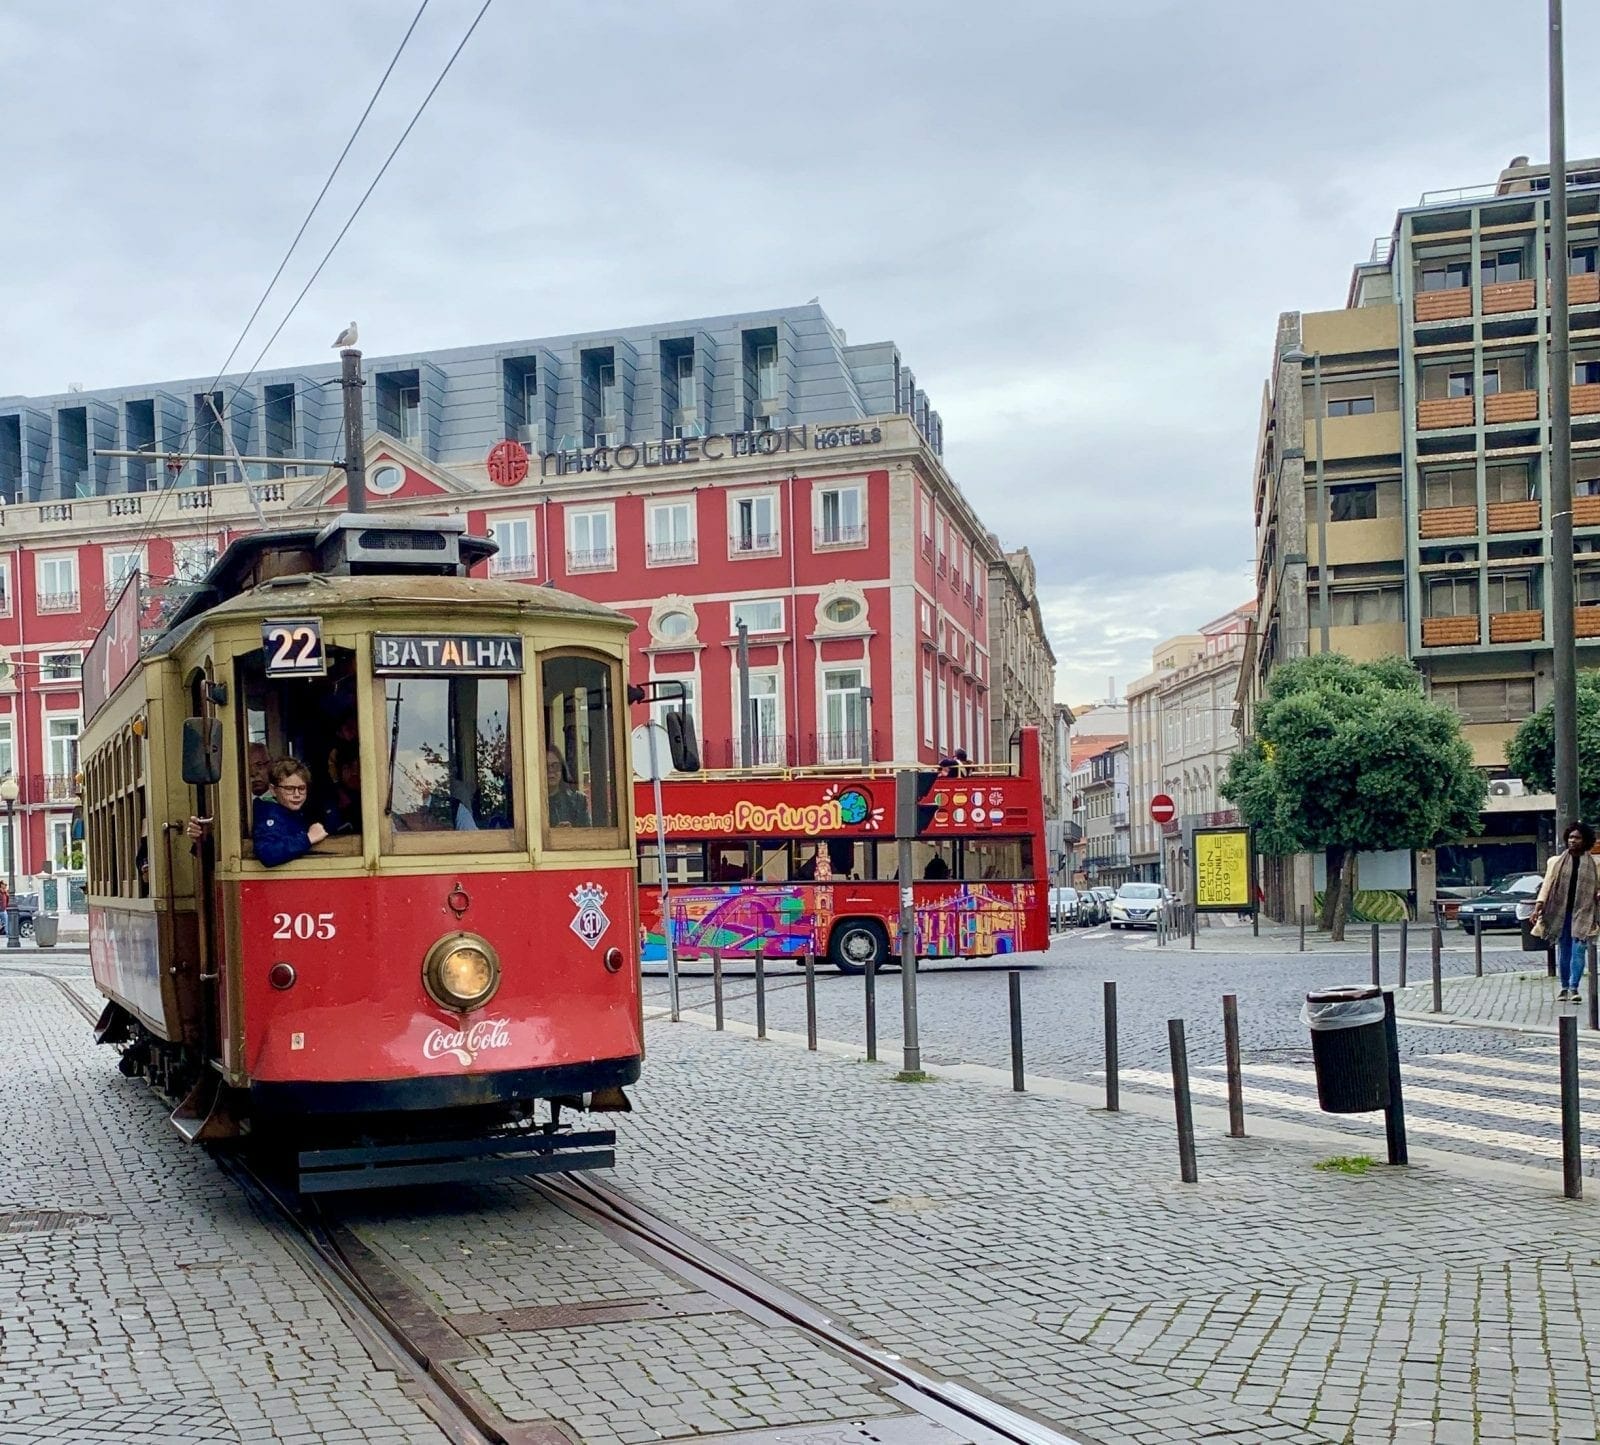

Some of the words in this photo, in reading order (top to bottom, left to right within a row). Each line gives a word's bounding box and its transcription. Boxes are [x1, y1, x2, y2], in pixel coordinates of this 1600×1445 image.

[593, 424, 807, 472] COLLECTION
[815, 427, 882, 449] HOTELS
[268, 627, 320, 668] 22
[381, 640, 517, 667] BATALHA
[735, 800, 842, 835] Portugal
[1223, 872, 1231, 902] 2019
[272, 912, 336, 940] 205
